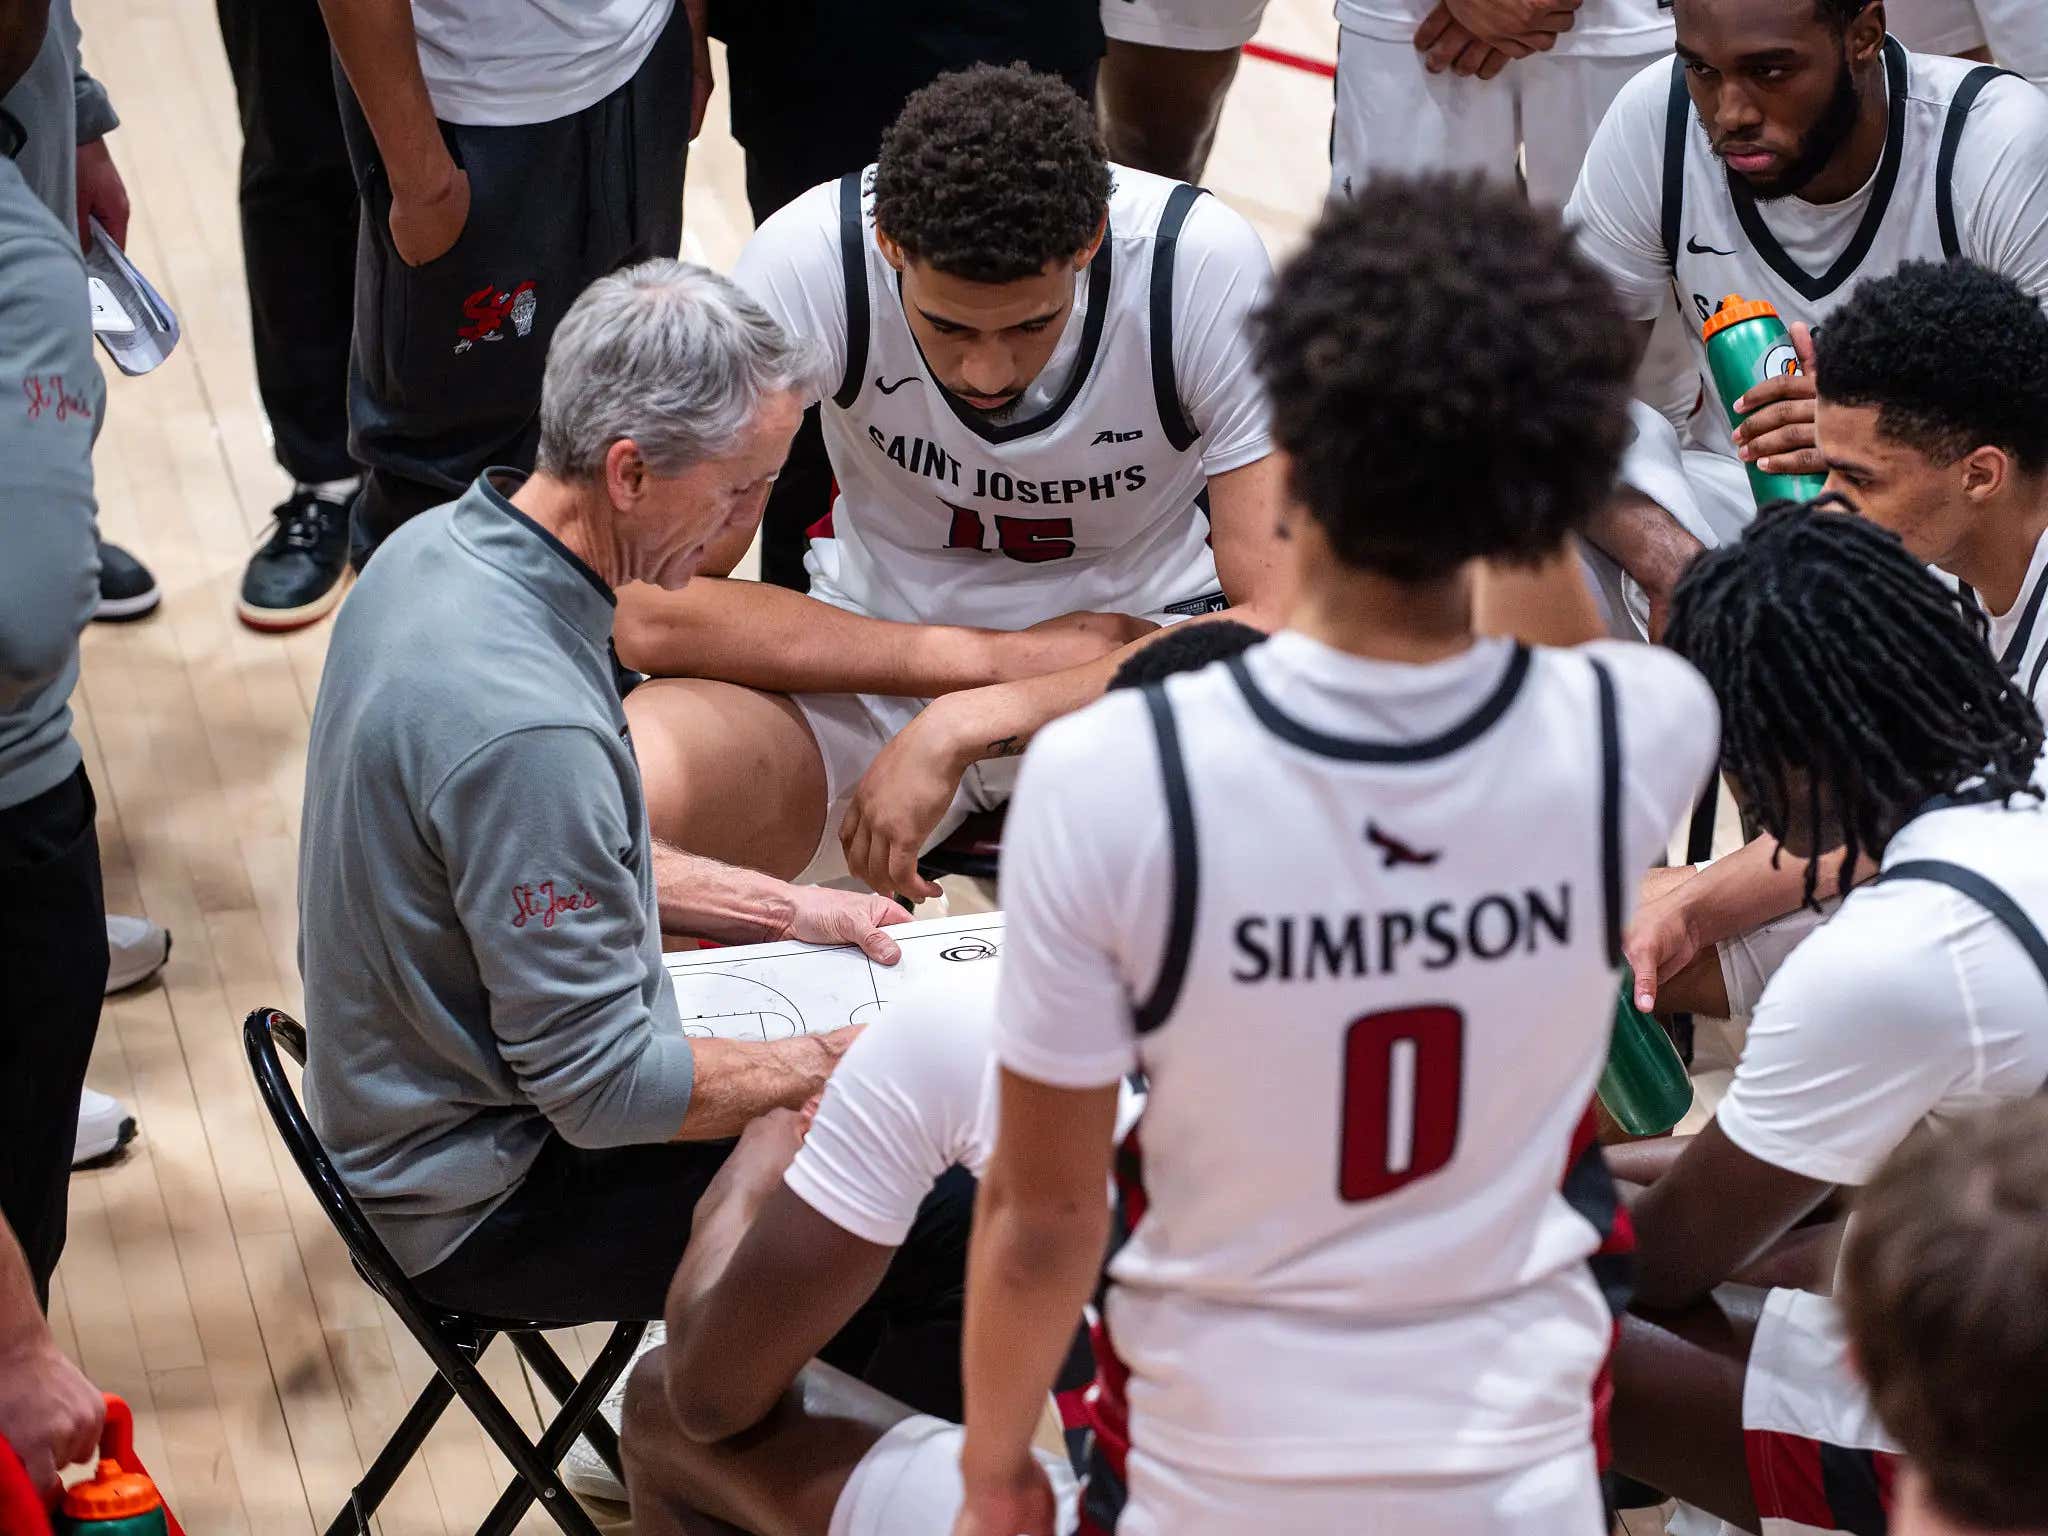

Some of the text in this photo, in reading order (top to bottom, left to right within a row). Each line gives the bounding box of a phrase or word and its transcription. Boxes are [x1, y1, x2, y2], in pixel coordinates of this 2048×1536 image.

[868, 424, 1146, 504] SAINT JOSEPH'S
[935, 495, 1075, 563] 15
[539, 880, 598, 928] Joe's
[1232, 881, 1573, 984] SIMPSON
[1337, 1001, 1467, 1207] 0
